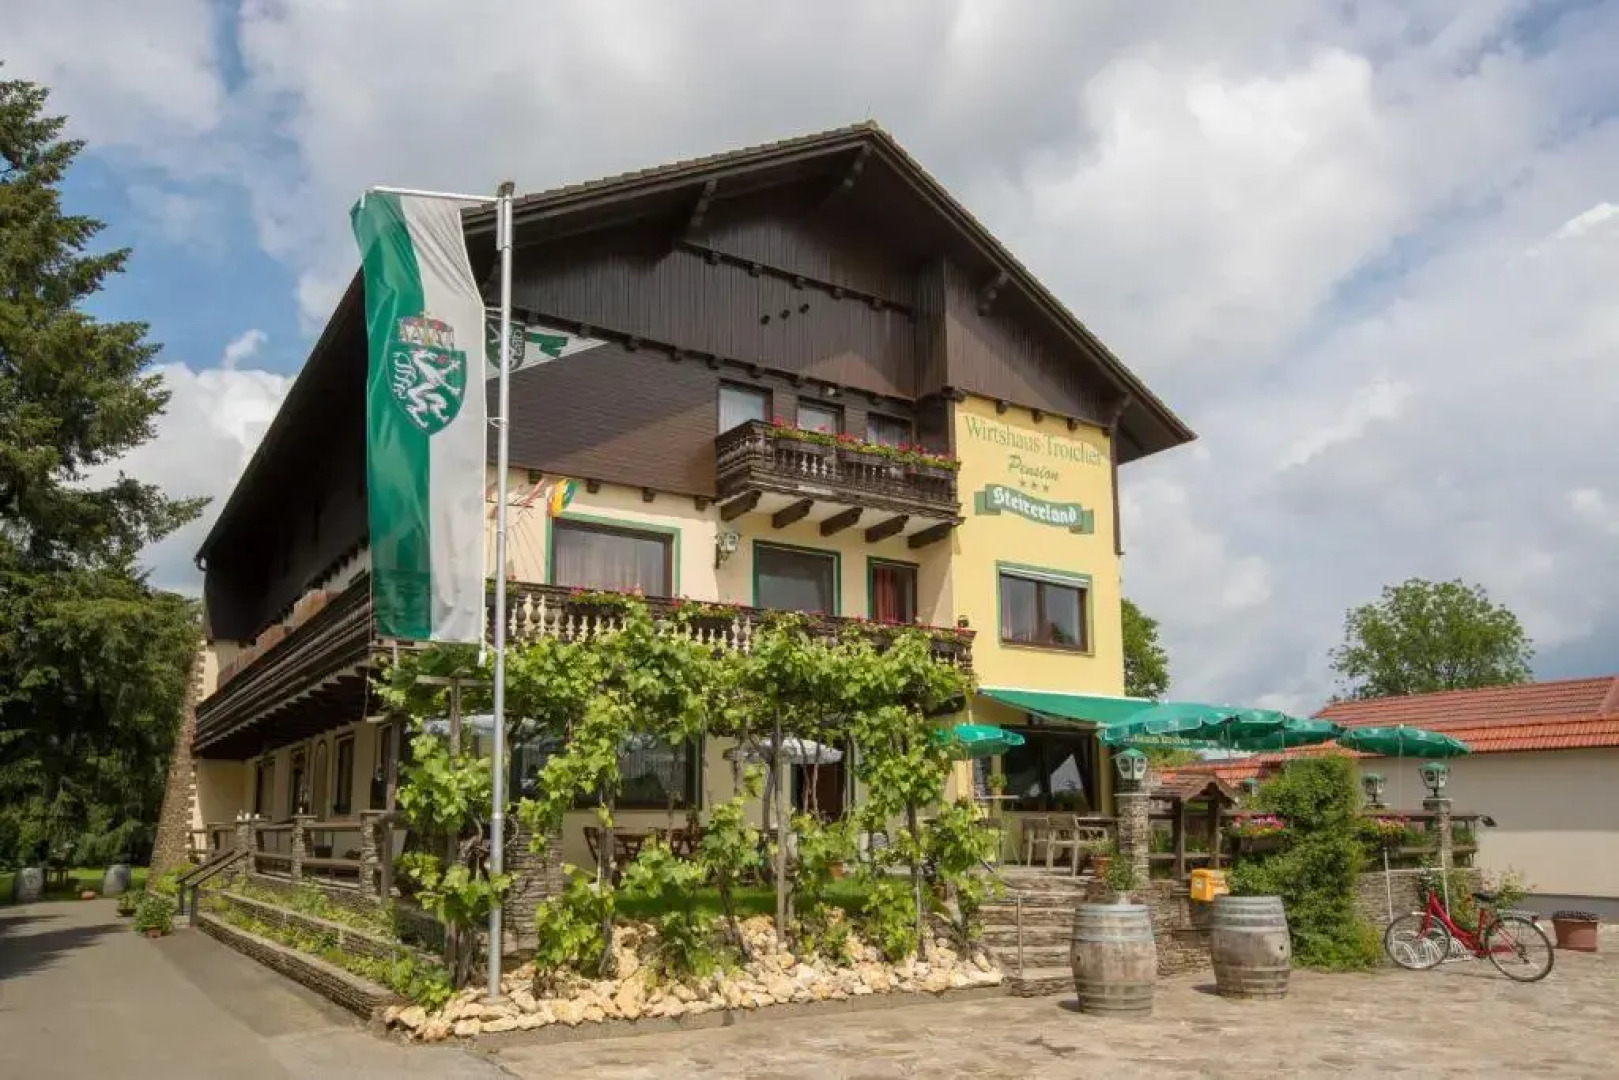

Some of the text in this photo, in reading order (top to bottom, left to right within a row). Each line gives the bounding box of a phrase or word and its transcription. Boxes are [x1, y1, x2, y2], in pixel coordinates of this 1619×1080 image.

[965, 415, 1040, 454] Wirtshaus
[1009, 454, 1059, 481] Pension
[992, 486, 1077, 524] Steirerland
